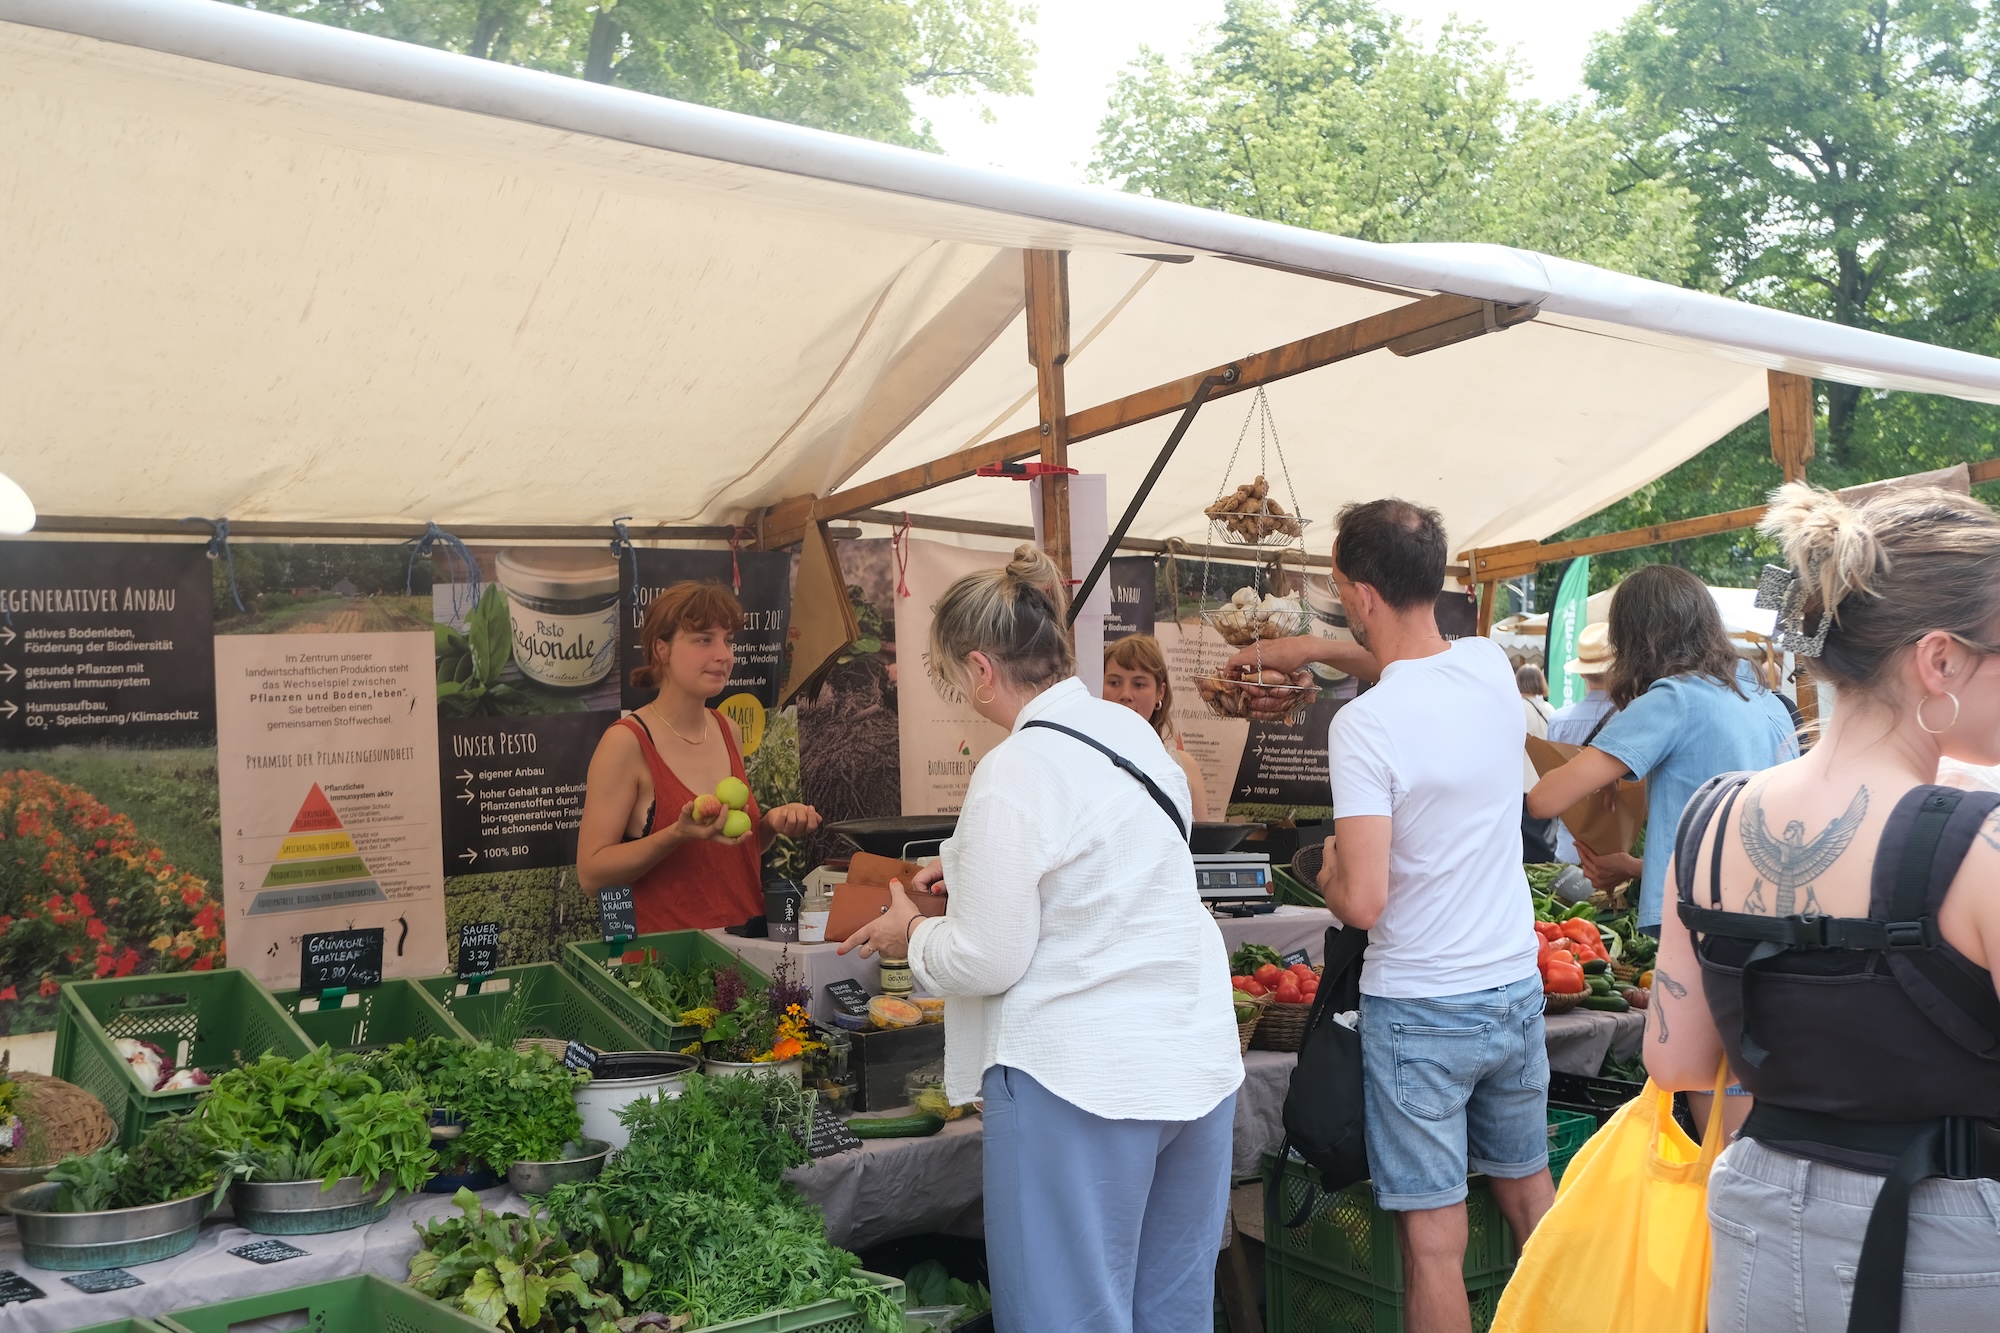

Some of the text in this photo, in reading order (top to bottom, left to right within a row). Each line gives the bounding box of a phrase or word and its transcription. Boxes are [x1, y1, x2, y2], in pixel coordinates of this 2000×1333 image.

[124, 587, 176, 612] ANBAU
[1117, 585, 1141, 604] ANBAU
[25, 627, 135, 640] aktives Bodenleben,
[535, 620, 564, 637] Pesto
[1109, 623, 1137, 631] Biodiversität
[25, 640, 173, 655] Förderung der Biodiversität
[511, 617, 596, 666] Regionale
[731, 643, 758, 653] Berlin:
[285, 653, 372, 663] Im Zentrum unserer
[750, 653, 778, 665] Wedding
[25, 662, 144, 678] gesunde Pflanzen mit
[245, 664, 409, 677] landwirtschaftlichen Produktion steht
[25, 677, 150, 690] aktivem Immunsystem
[262, 677, 396, 690] das Wechselspiel zwischen
[250, 693, 302, 703] Pflanzen
[307, 691, 328, 701] und
[26, 700, 109, 713] Humusaufbau,
[289, 702, 373, 715] Sie betreiben einen
[727, 705, 754, 724] MACH
[267, 715, 392, 731] gemeinsamen Stoffwechsel.
[453, 731, 537, 757] UNSER PESTO
[1268, 733, 1304, 742] eigener Anbau
[1281, 747, 1297, 755] Gehalt
[246, 747, 414, 770] PYRAMIDE DER PFLANZENGESUNDHEIT
[1262, 755, 1302, 763] Pflanzenstoffen
[479, 767, 545, 782] eigener Anbau
[1260, 764, 1304, 772] bio-regenerativen
[1298, 774, 1329, 783] Verarbeitung
[324, 783, 365, 792] Pflanzliches
[480, 789, 506, 799] hoher
[508, 786, 539, 797] Gehalt
[541, 786, 551, 795] an
[1253, 786, 1279, 795] 100% BIO
[330, 790, 394, 801] Immunsystem aktiv
[481, 795, 579, 811] Pflanzenstoffen durch
[481, 809, 562, 824] bio-regenerativen
[237, 829, 243, 837] 4
[482, 826, 500, 836] und
[502, 821, 553, 835] schonende
[282, 843, 318, 854] SPEICHERUNG
[318, 842, 330, 851] VON
[484, 845, 529, 858] 100% BIO
[238, 855, 244, 864] 3
[271, 868, 303, 880] PRODUKTION
[304, 868, 317, 877] VON
[239, 882, 245, 890] 2
[384, 884, 431, 895] gegen Pathogene
[601, 891, 621, 901] WILD
[602, 900, 633, 911] KRÄUTER
[784, 897, 795, 921] Coffee
[241, 909, 245, 917] 1
[603, 912, 617, 920] MIX
[462, 923, 498, 935] SAUER-
[309, 936, 365, 953] GRÜNKOHL
[461, 933, 499, 947] AMPFER
